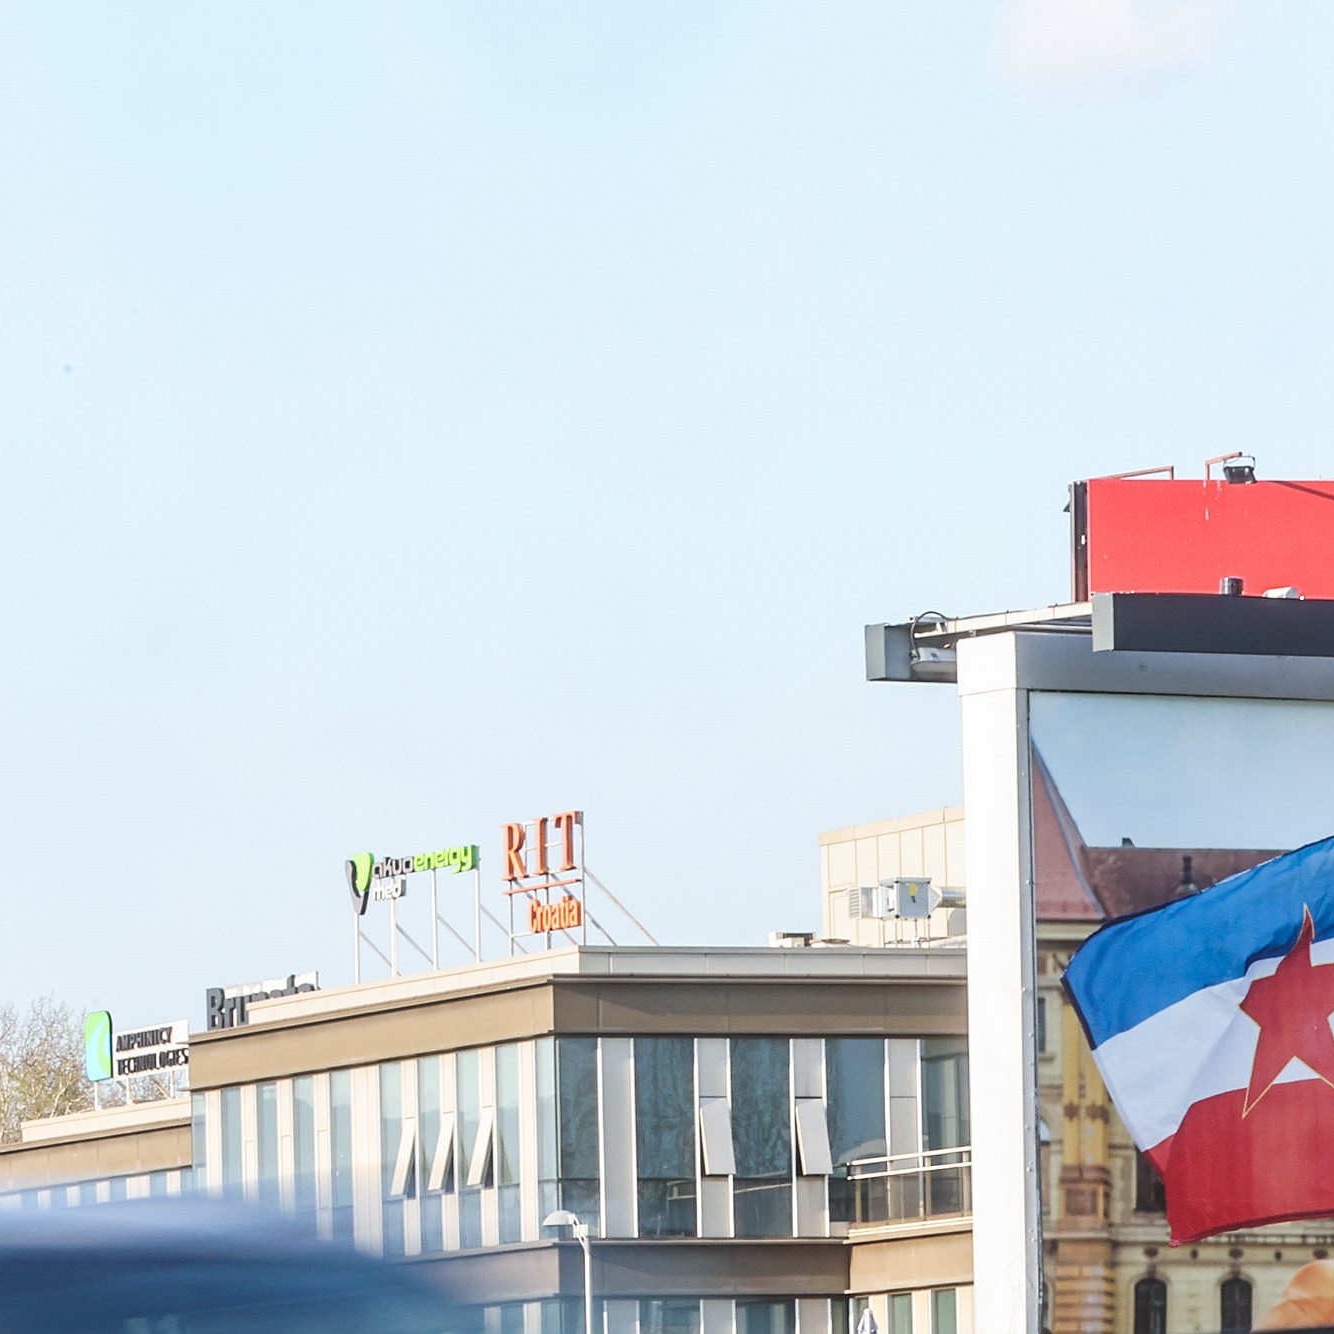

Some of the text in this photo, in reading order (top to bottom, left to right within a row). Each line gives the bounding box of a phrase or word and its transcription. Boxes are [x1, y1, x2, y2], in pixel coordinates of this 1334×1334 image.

[501, 810, 583, 881] RIT
[372, 875, 406, 901] med
[527, 895, 582, 933] Croatia
